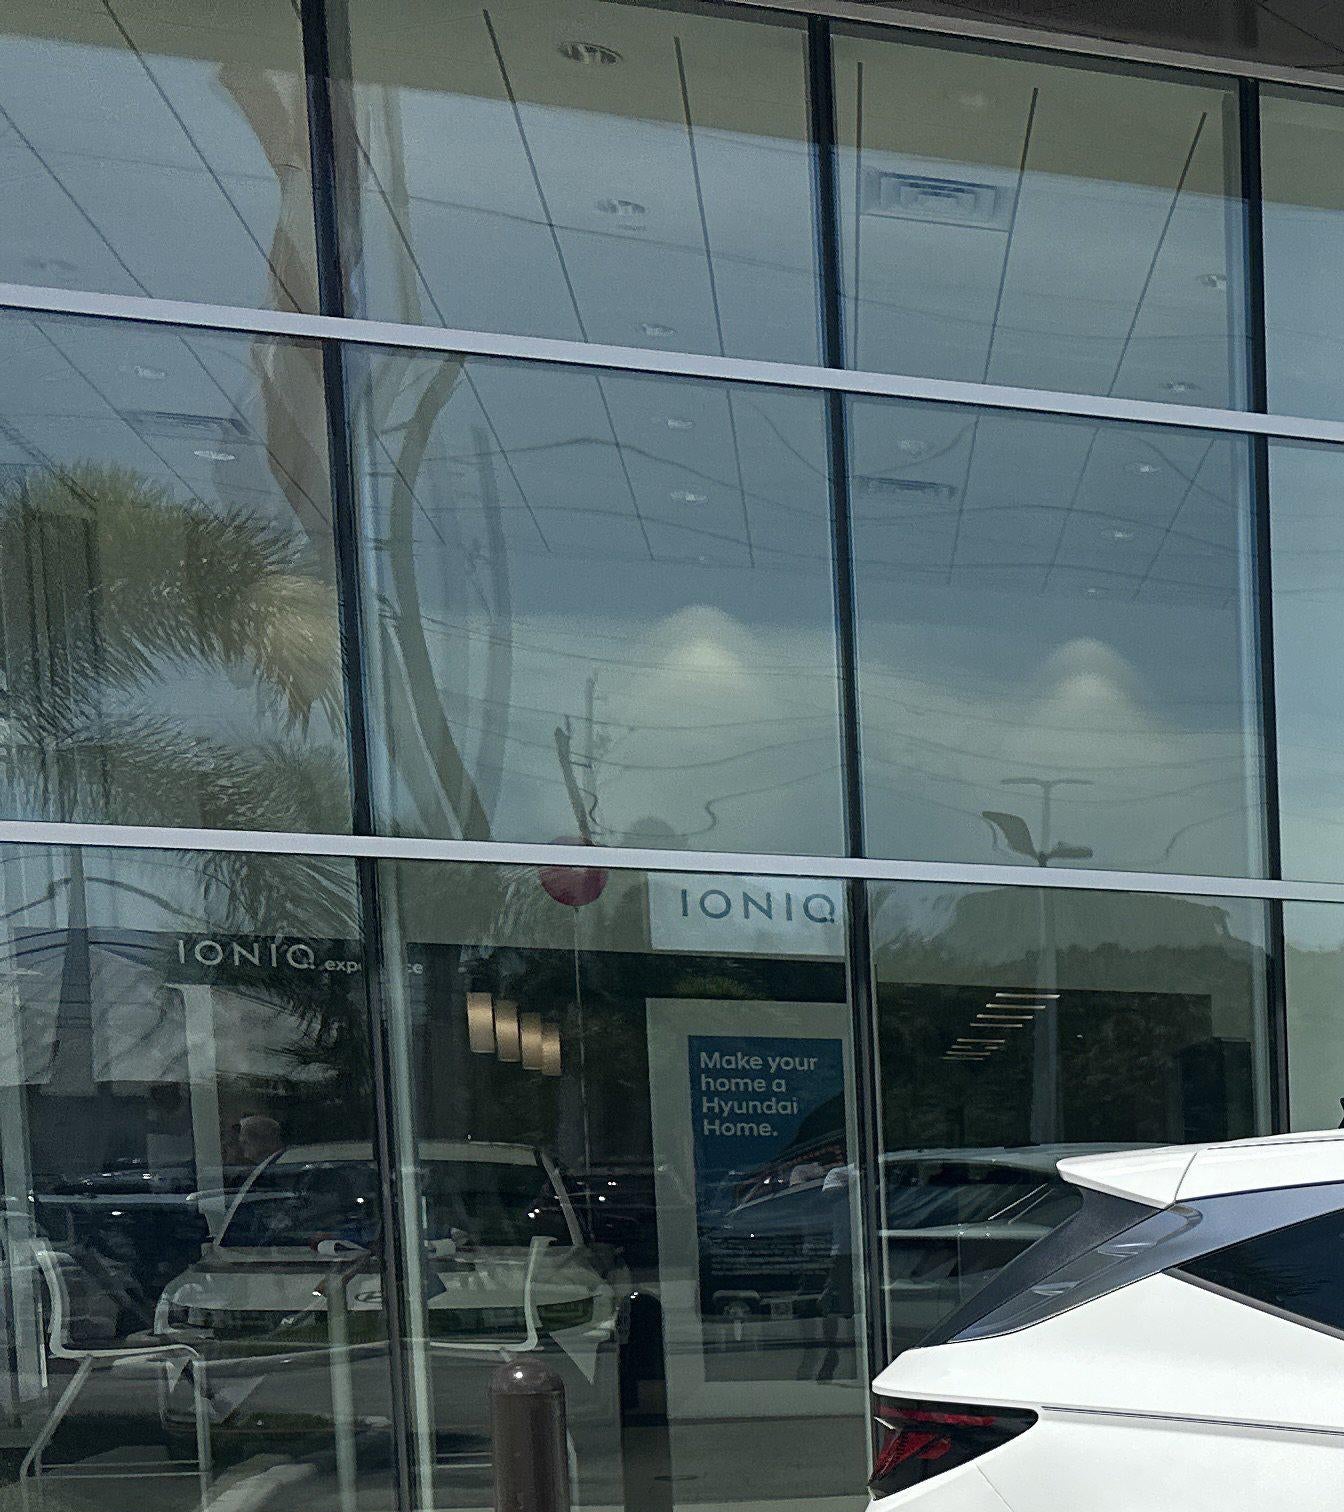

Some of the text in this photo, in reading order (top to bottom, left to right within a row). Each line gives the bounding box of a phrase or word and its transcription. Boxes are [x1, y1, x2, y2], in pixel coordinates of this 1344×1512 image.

[681, 888, 836, 924] IONIQ
[178, 939, 316, 969] IONIQ
[700, 1051, 818, 1073] Make your
[701, 1073, 787, 1093] home a
[702, 1096, 800, 1117] Hyundai
[703, 1119, 779, 1137] Home.
